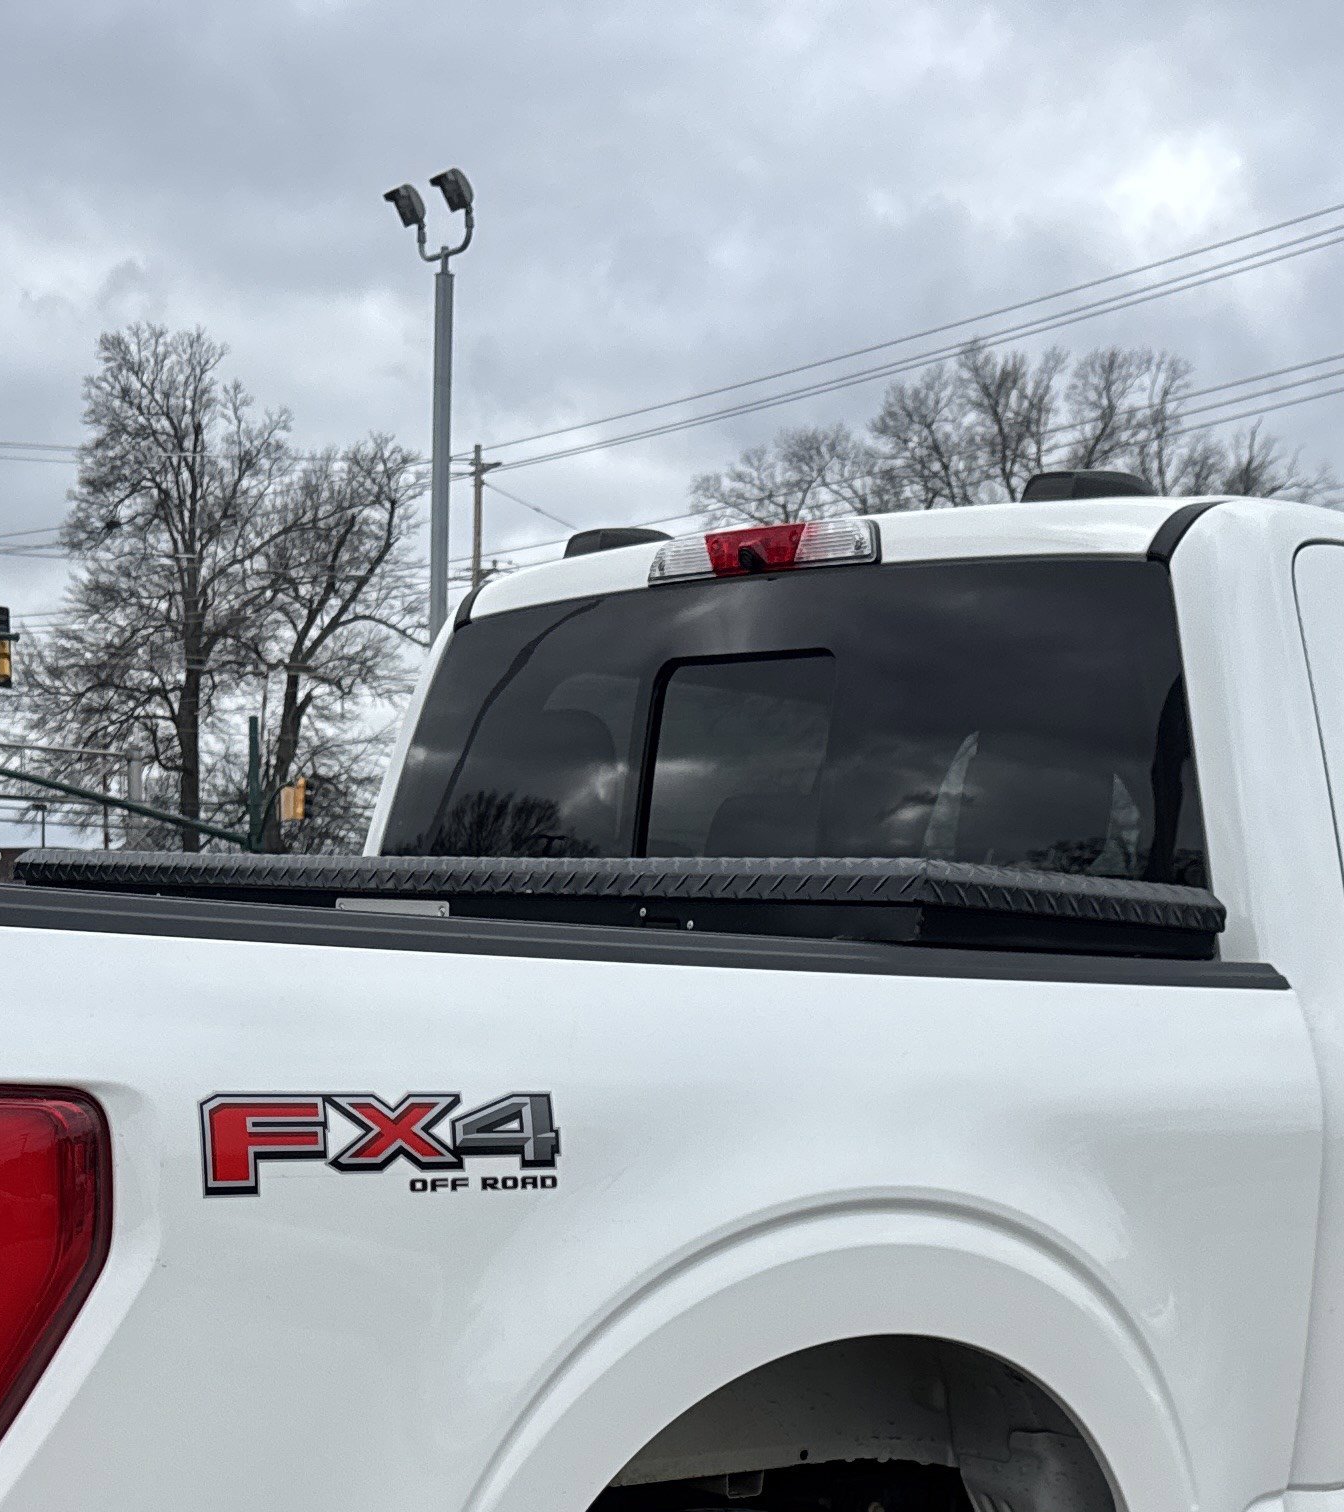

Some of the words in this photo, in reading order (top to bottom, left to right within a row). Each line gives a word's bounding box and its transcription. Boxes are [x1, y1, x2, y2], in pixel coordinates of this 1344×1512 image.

[197, 1090, 562, 1198] FX4
[409, 1177, 470, 1193] OFF
[480, 1175, 558, 1191] ROAD
